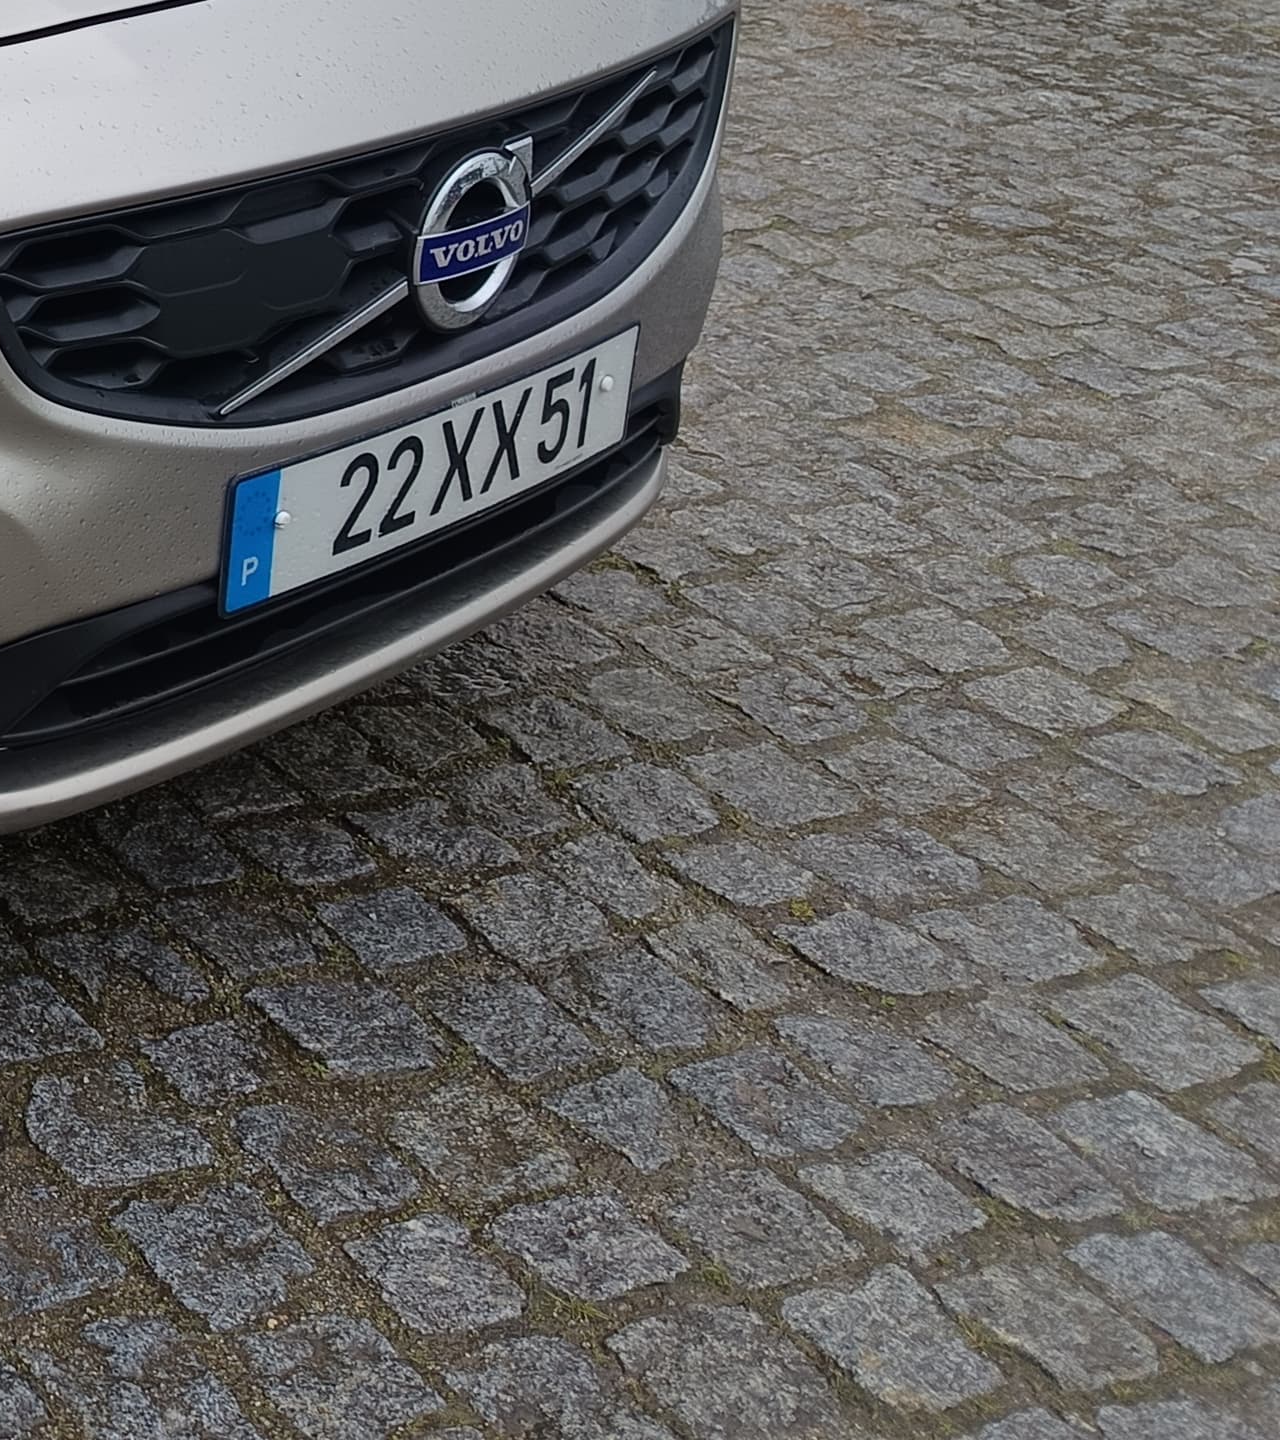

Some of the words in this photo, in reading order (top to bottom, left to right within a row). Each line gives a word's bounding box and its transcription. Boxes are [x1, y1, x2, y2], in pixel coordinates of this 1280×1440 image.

[429, 219, 524, 268] VOLVO
[241, 556, 259, 587] P
[331, 357, 597, 556] 22XX51
